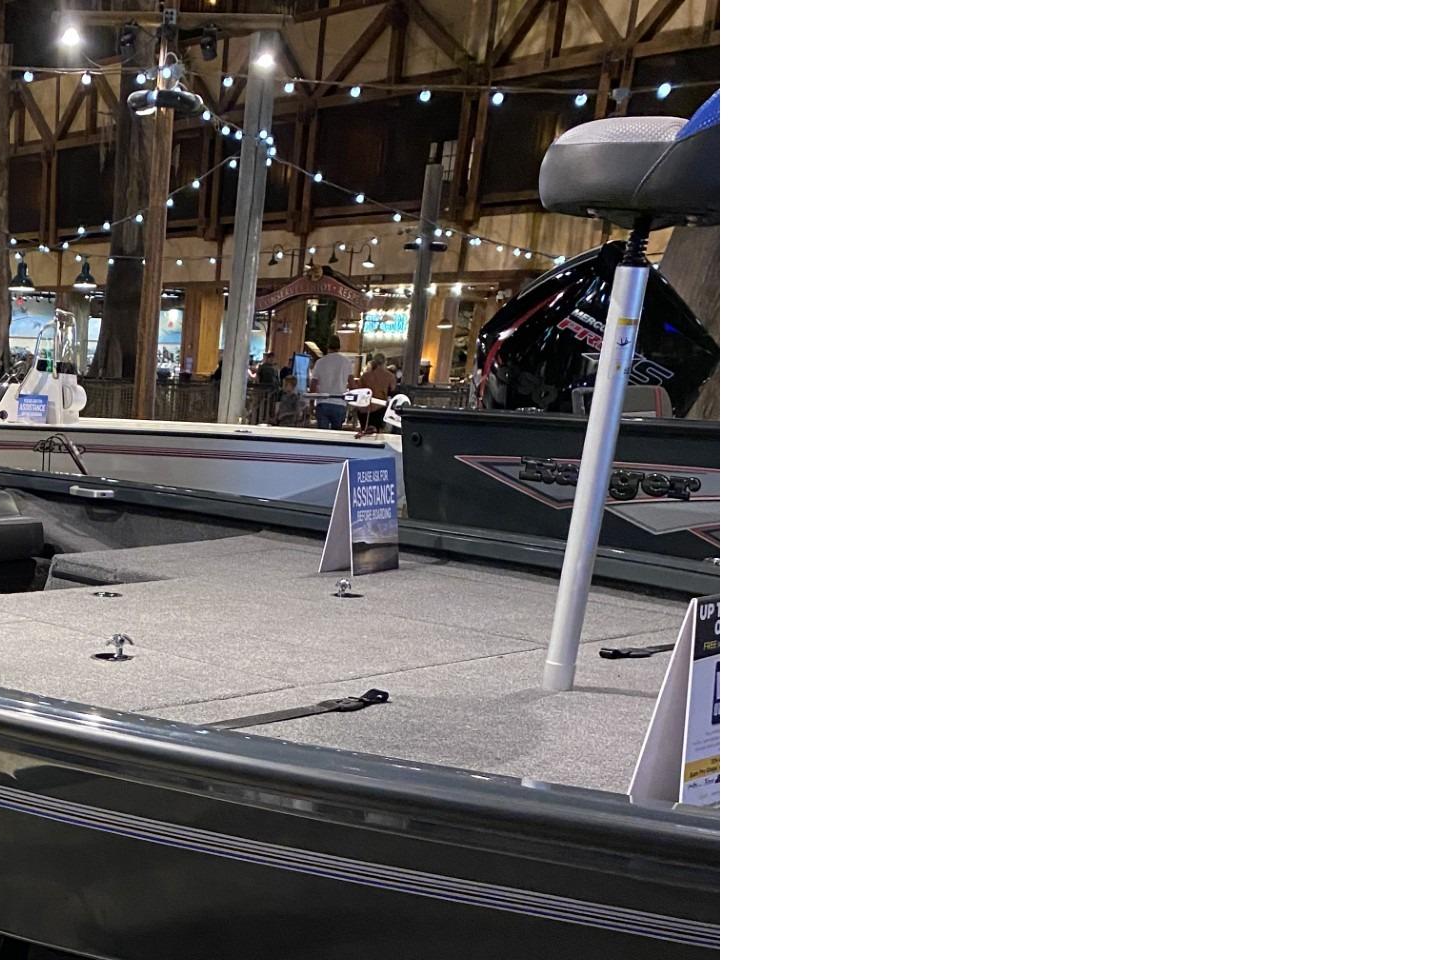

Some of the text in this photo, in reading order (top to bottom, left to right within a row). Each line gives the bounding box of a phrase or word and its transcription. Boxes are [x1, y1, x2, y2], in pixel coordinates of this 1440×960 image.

[519, 456, 702, 500] Rager
[352, 483, 396, 508] ASSISTANCE
[699, 602, 715, 621] UP
